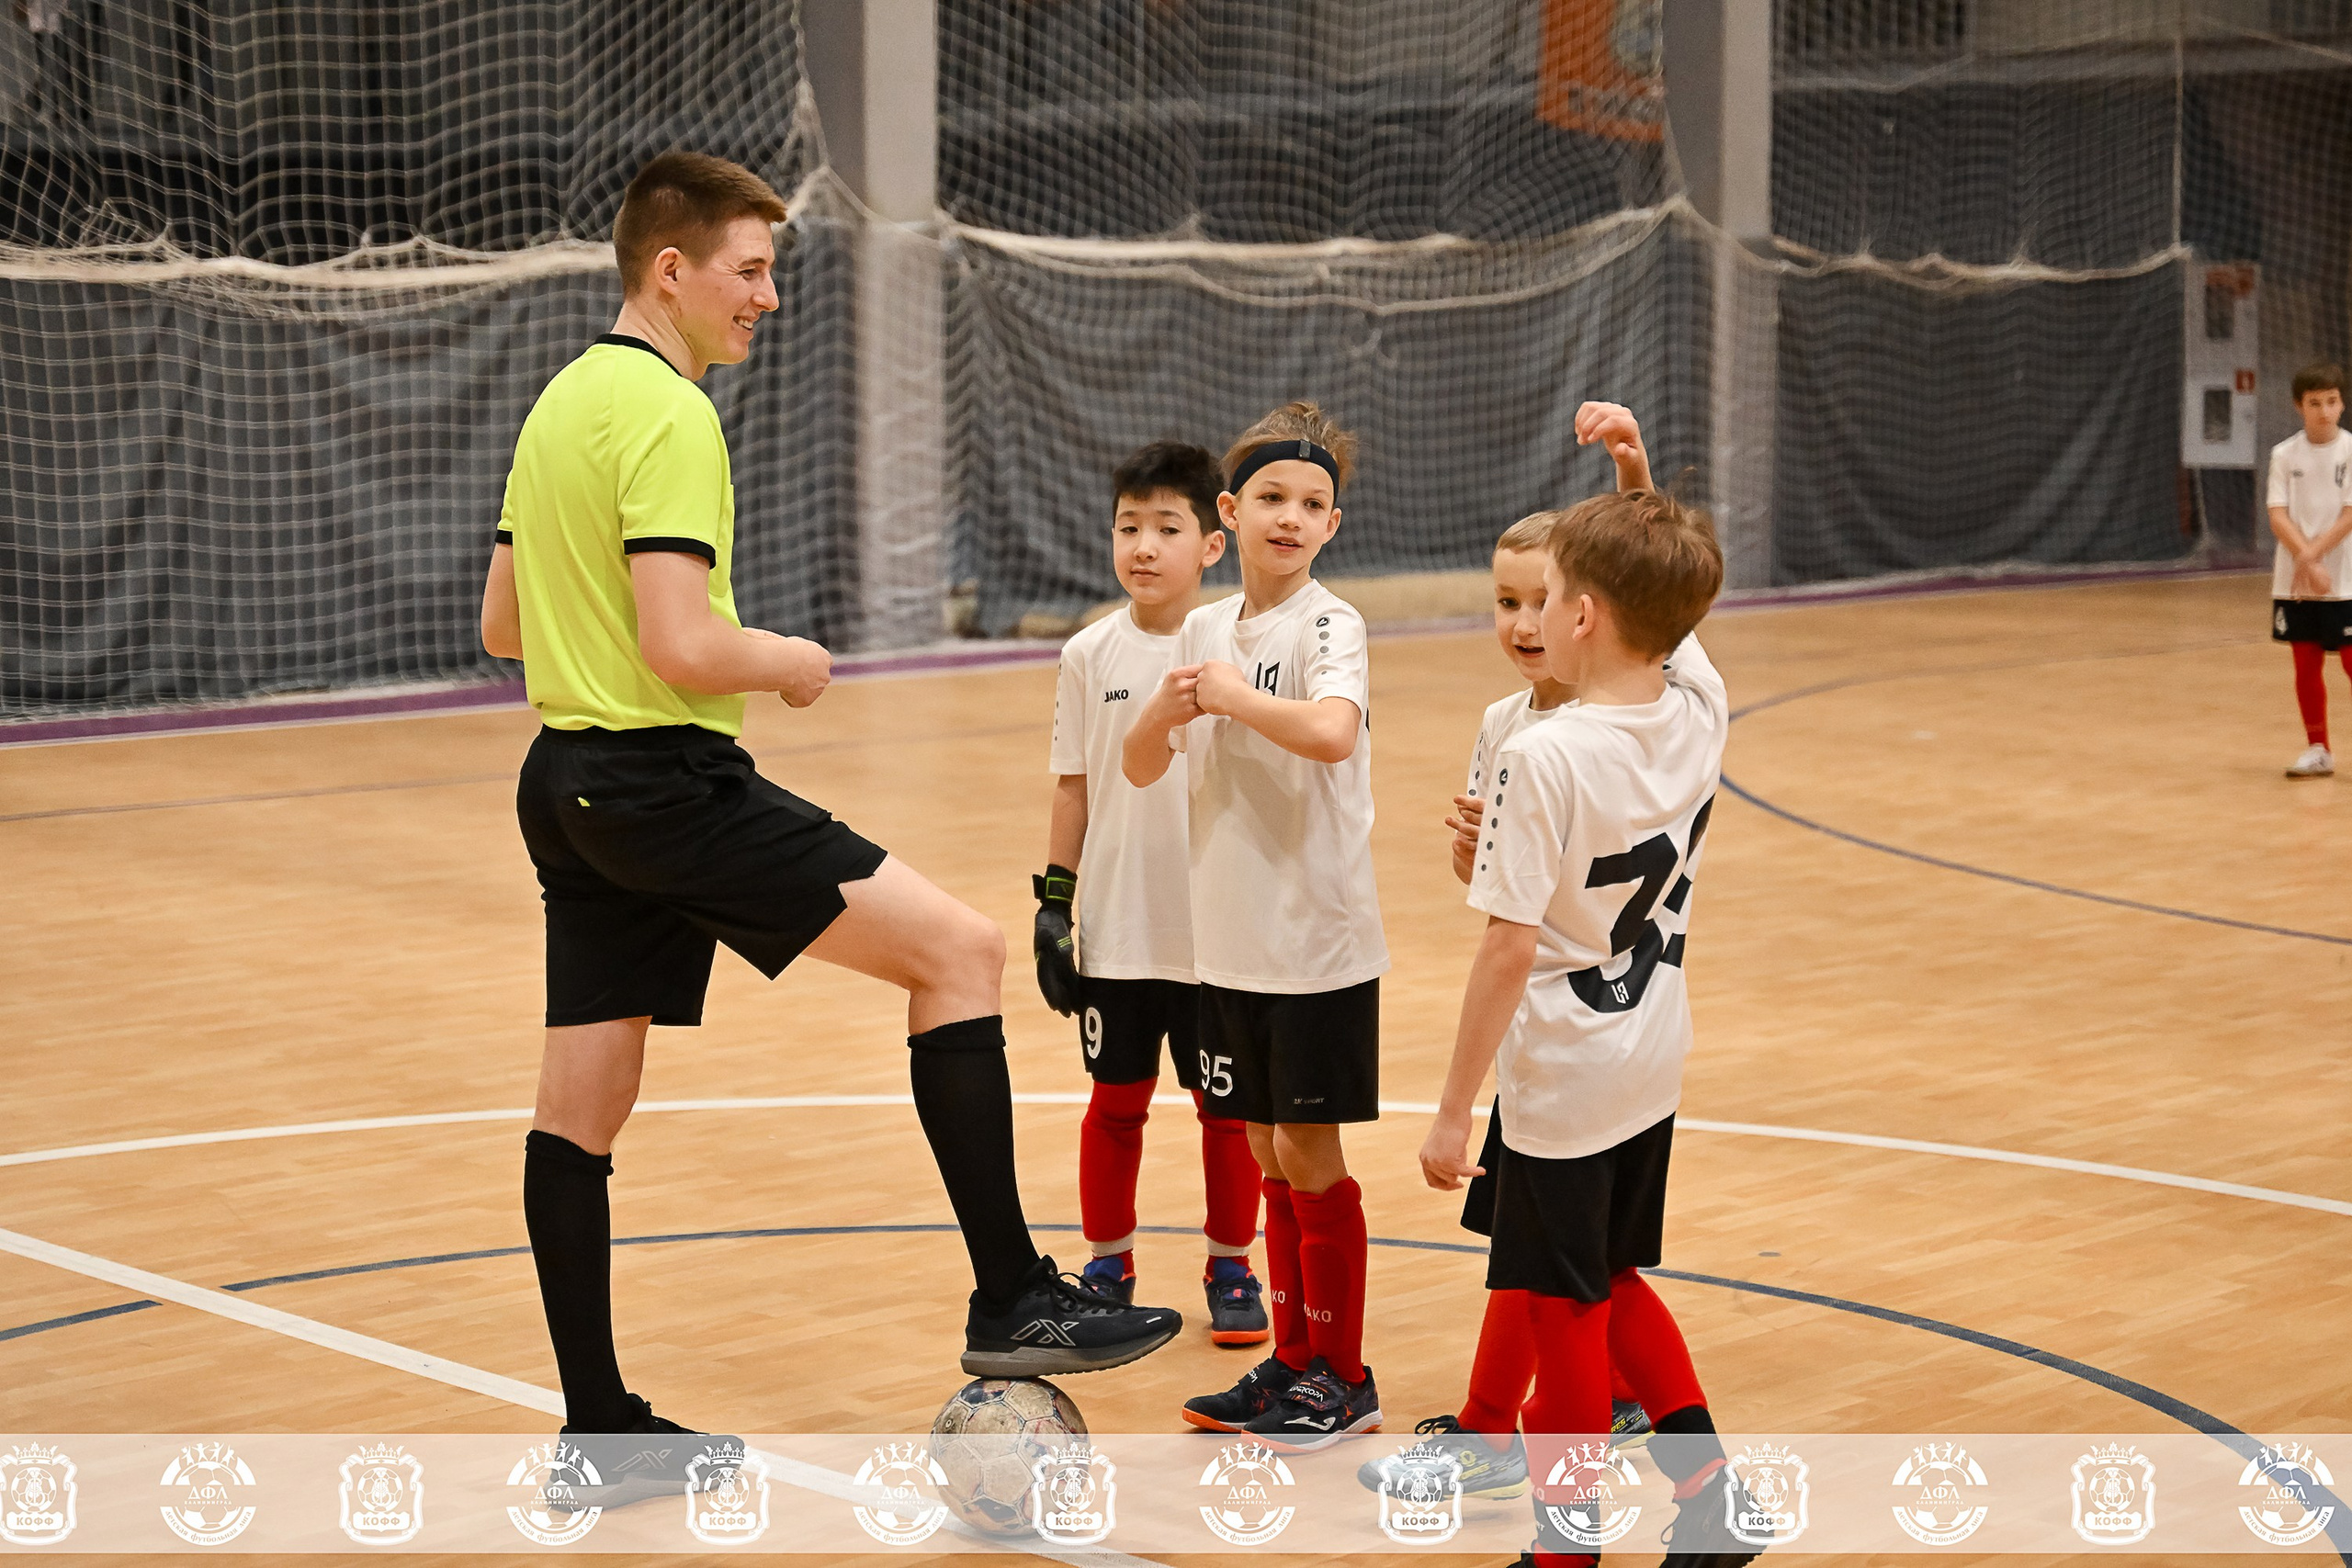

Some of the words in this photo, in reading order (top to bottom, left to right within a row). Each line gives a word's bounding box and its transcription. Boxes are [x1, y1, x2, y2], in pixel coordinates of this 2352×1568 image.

[1104, 689, 1129, 703] JAKO
[1085, 1007, 1102, 1059] 9
[1199, 1049, 1233, 1097] 95
